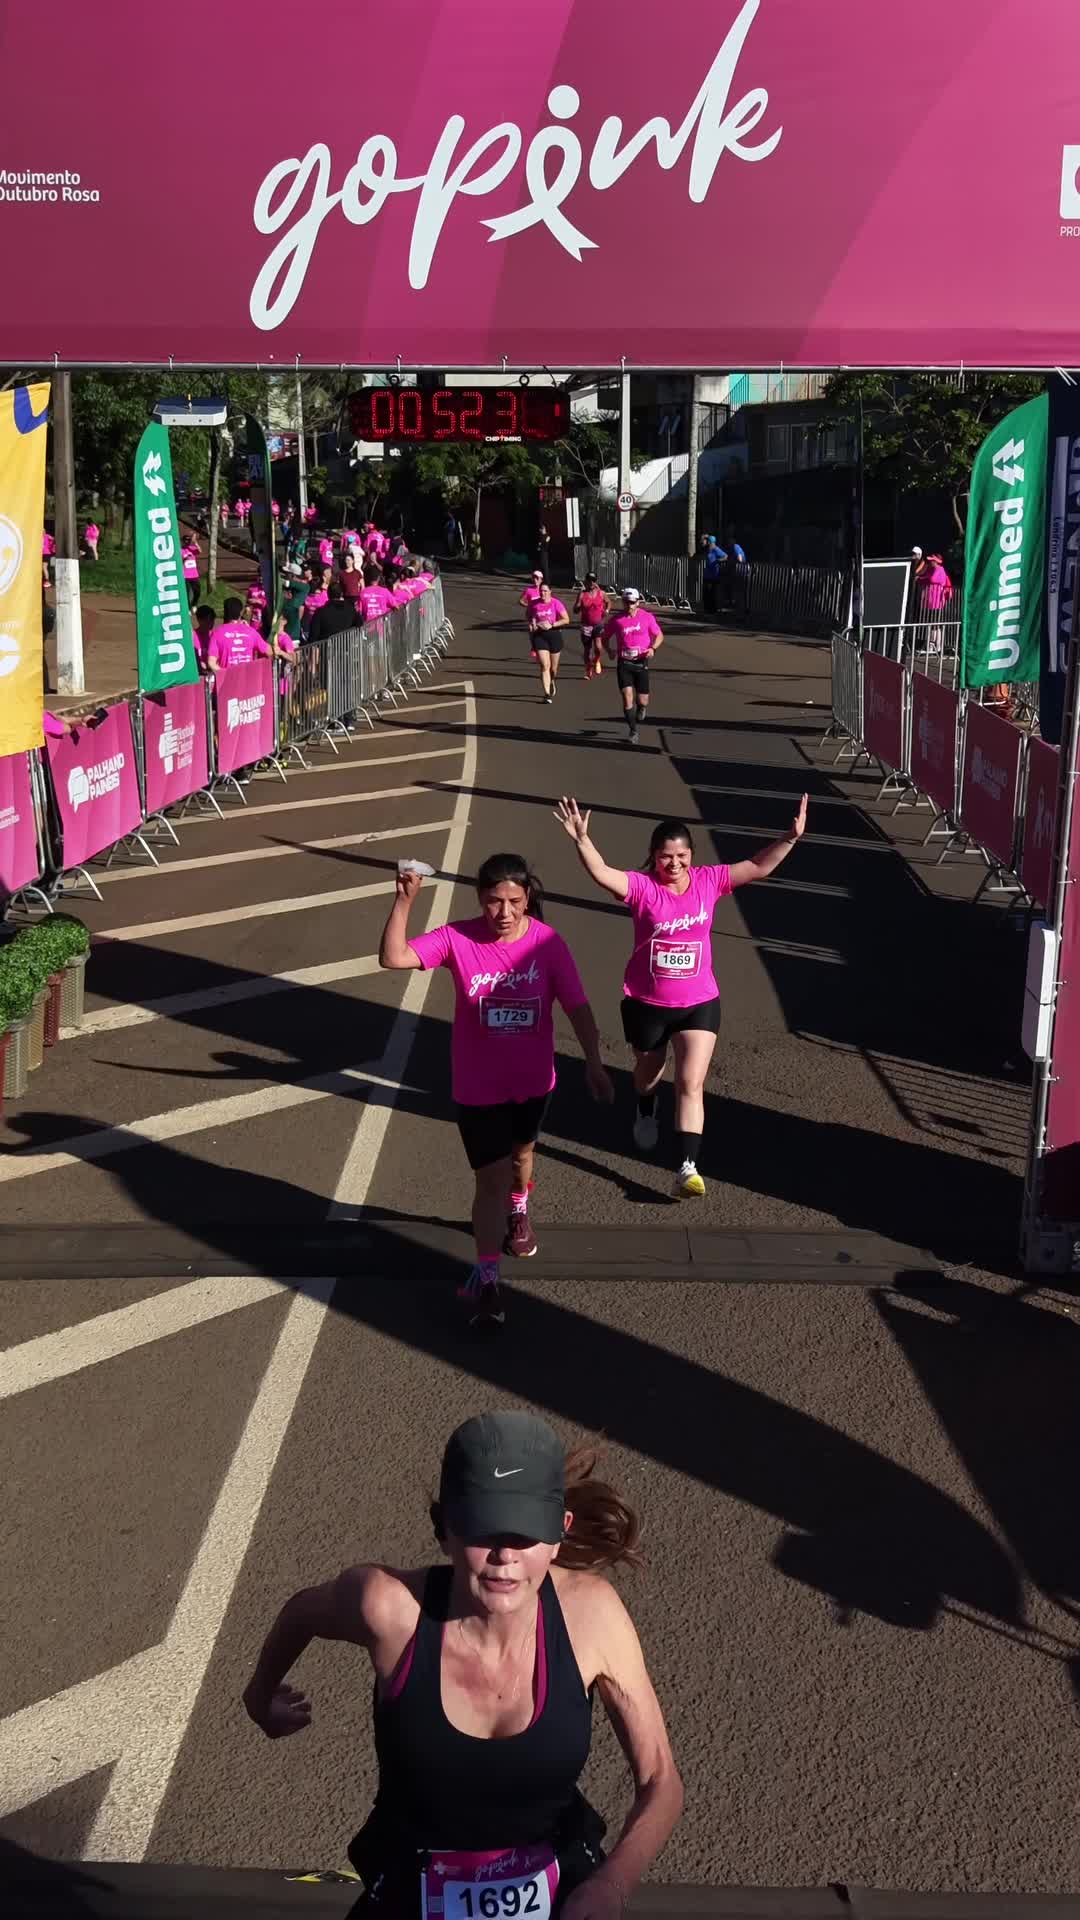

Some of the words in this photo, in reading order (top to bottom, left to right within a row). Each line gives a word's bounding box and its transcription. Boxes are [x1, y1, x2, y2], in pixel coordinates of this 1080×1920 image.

[249, 0, 783, 331] gopink
[62, 187, 100, 202] Rosa
[620, 495, 632, 504] 40
[147, 507, 187, 674] Unimed
[988, 496, 1025, 671] Unimed
[468, 959, 540, 997] gopink
[663, 953, 691, 966] 1869
[494, 1010, 528, 1022] 1729
[459, 1880, 541, 1919] 1692
